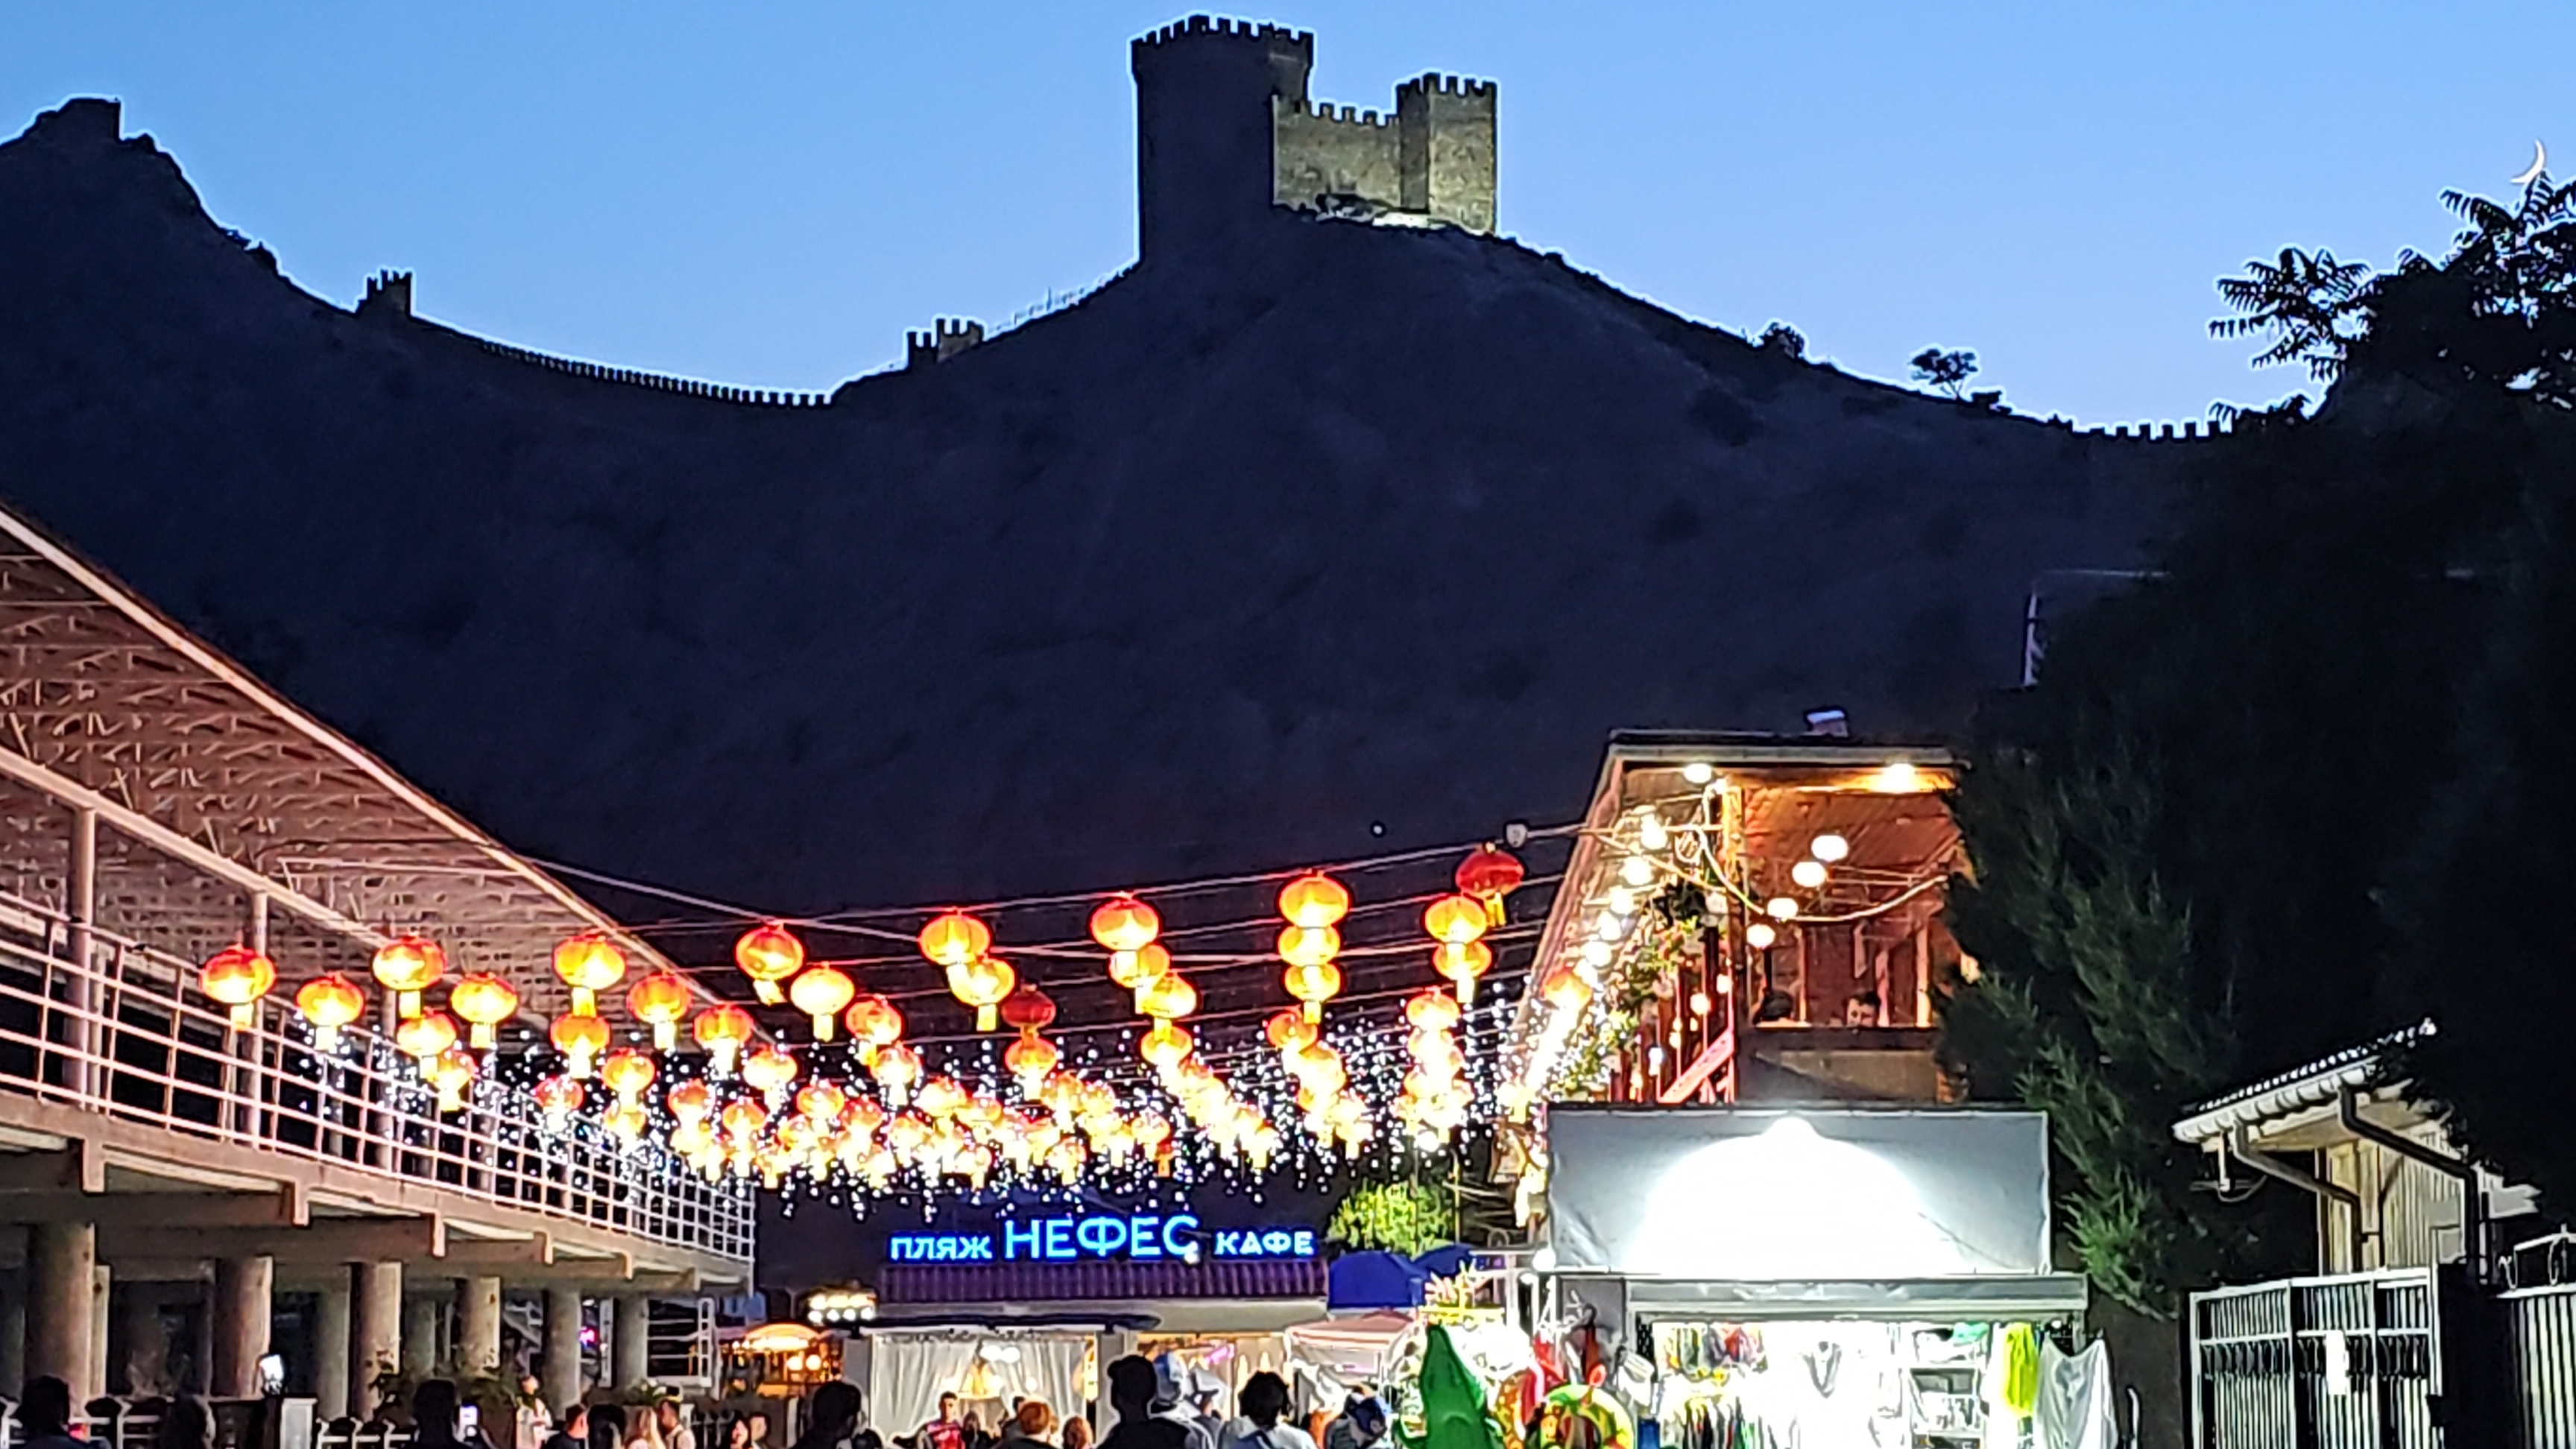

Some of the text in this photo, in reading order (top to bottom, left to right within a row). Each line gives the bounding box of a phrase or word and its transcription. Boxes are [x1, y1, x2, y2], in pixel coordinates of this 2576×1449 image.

[890, 1215, 1315, 1260] ПЛЯЖ НЕФЕС КАФЕ
